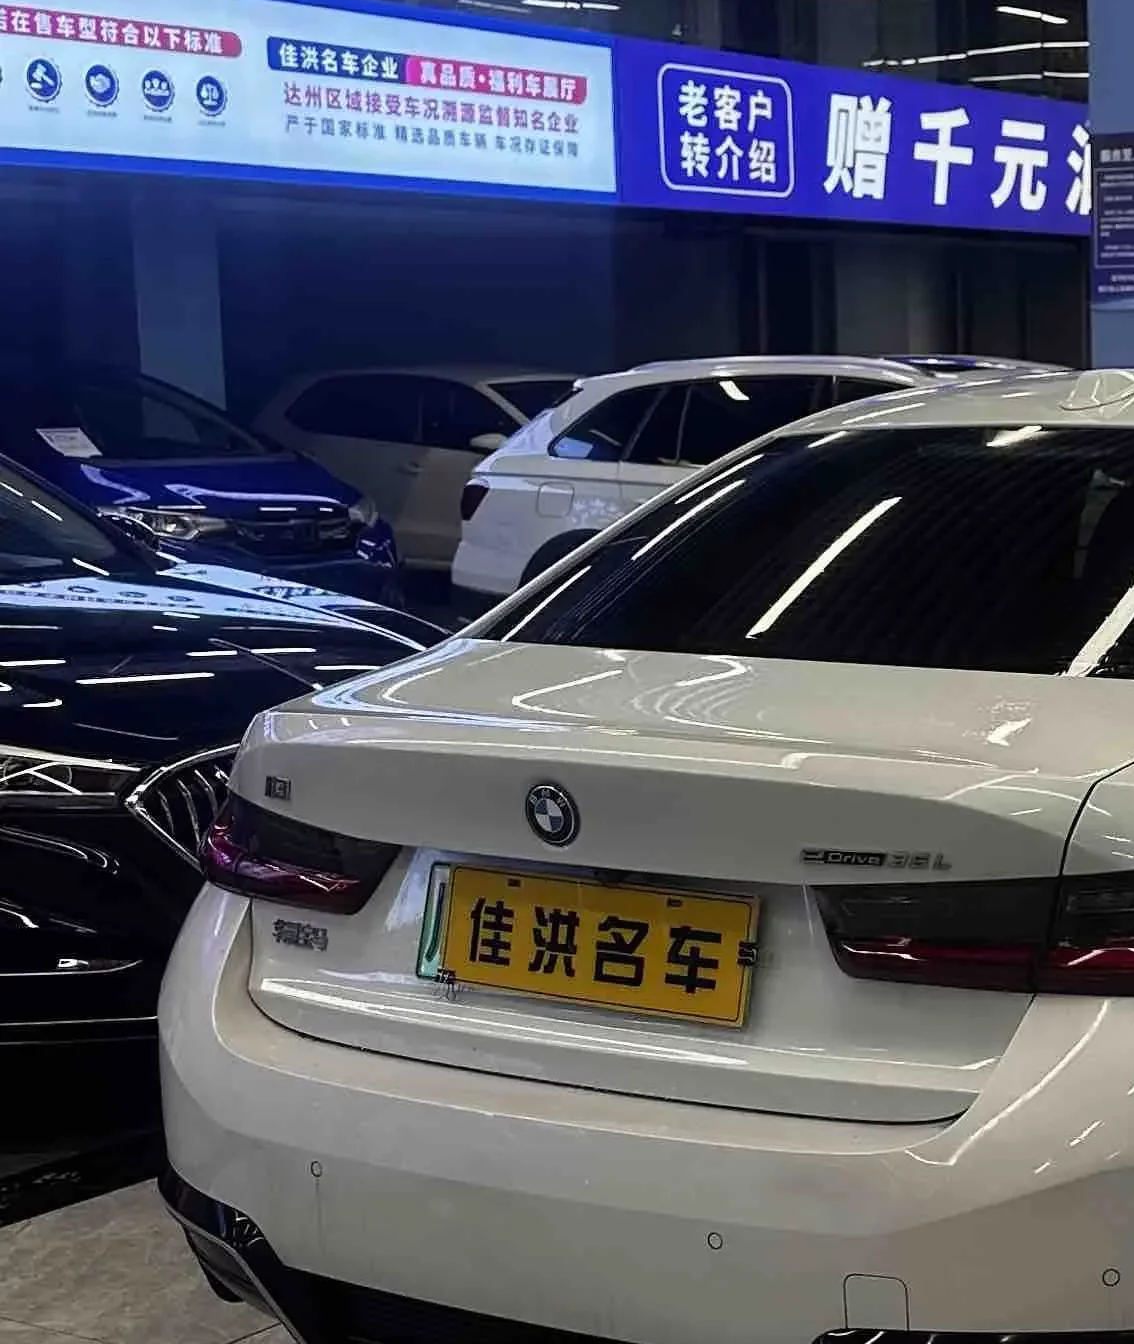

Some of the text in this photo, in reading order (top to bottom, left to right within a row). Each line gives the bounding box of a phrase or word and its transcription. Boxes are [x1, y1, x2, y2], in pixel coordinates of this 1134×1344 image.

[279, 43, 399, 80] 佳洪名车企业
[285, 115, 386, 141] 严于国家标准
[678, 80, 774, 132] 老客户
[679, 131, 777, 184] 转介绍
[467, 895, 722, 994] 佳洪名车
